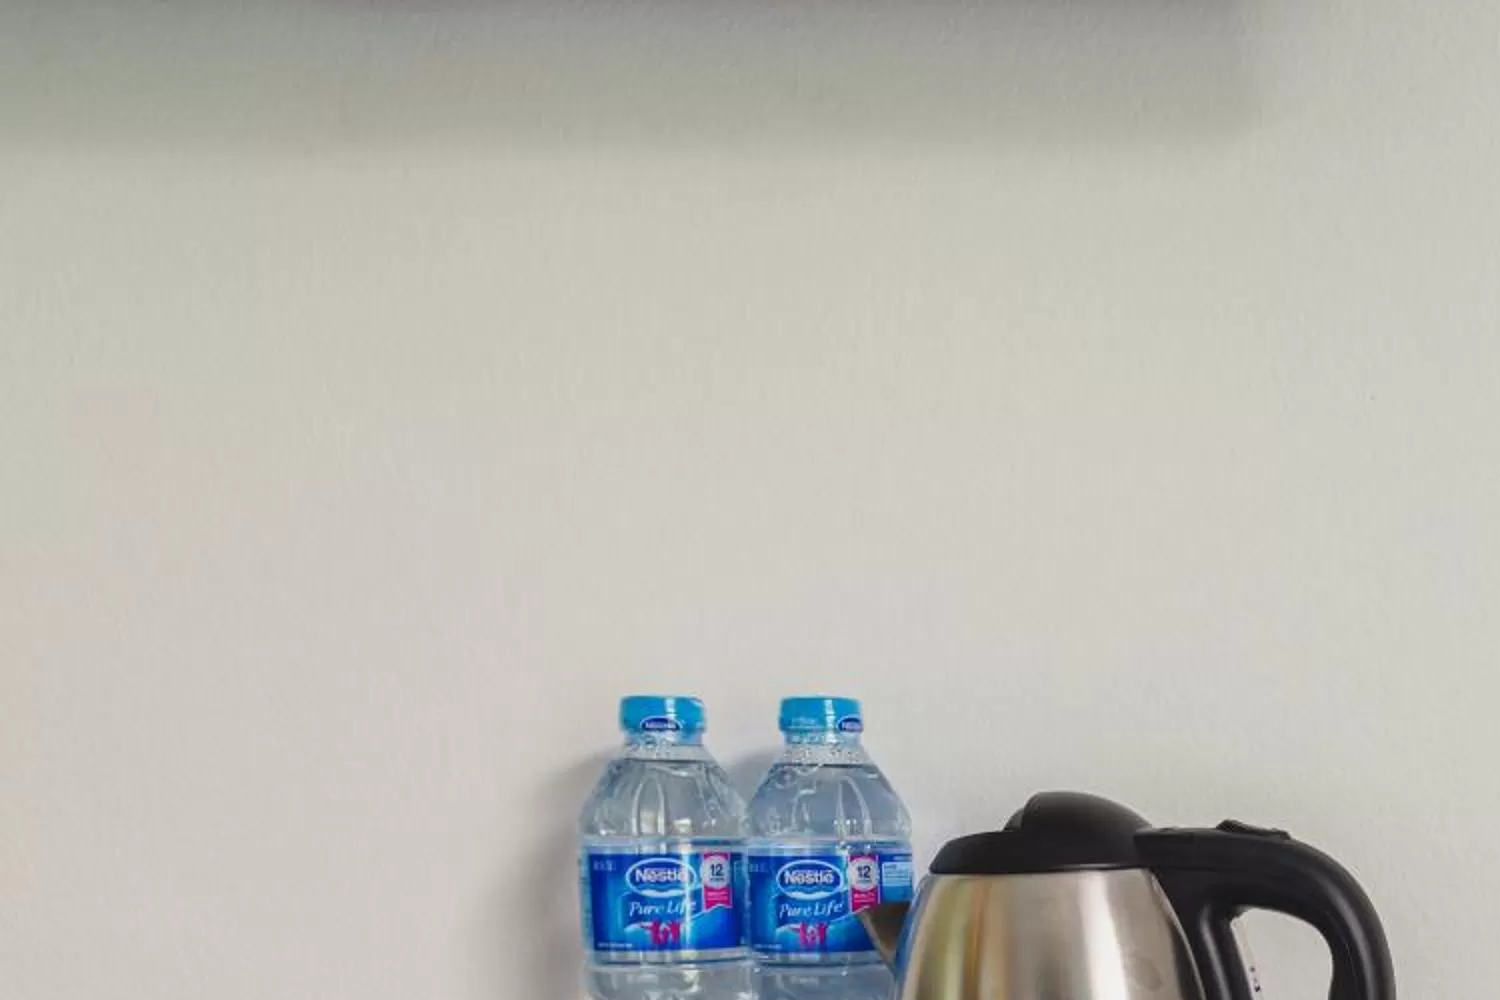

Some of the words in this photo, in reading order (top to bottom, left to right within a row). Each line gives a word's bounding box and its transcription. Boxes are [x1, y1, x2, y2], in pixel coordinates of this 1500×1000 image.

[710, 863, 725, 877] 12
[857, 865, 871, 879] 12
[629, 901, 664, 917] Pure
[779, 903, 812, 919] Pure
[814, 901, 844, 917] Life
